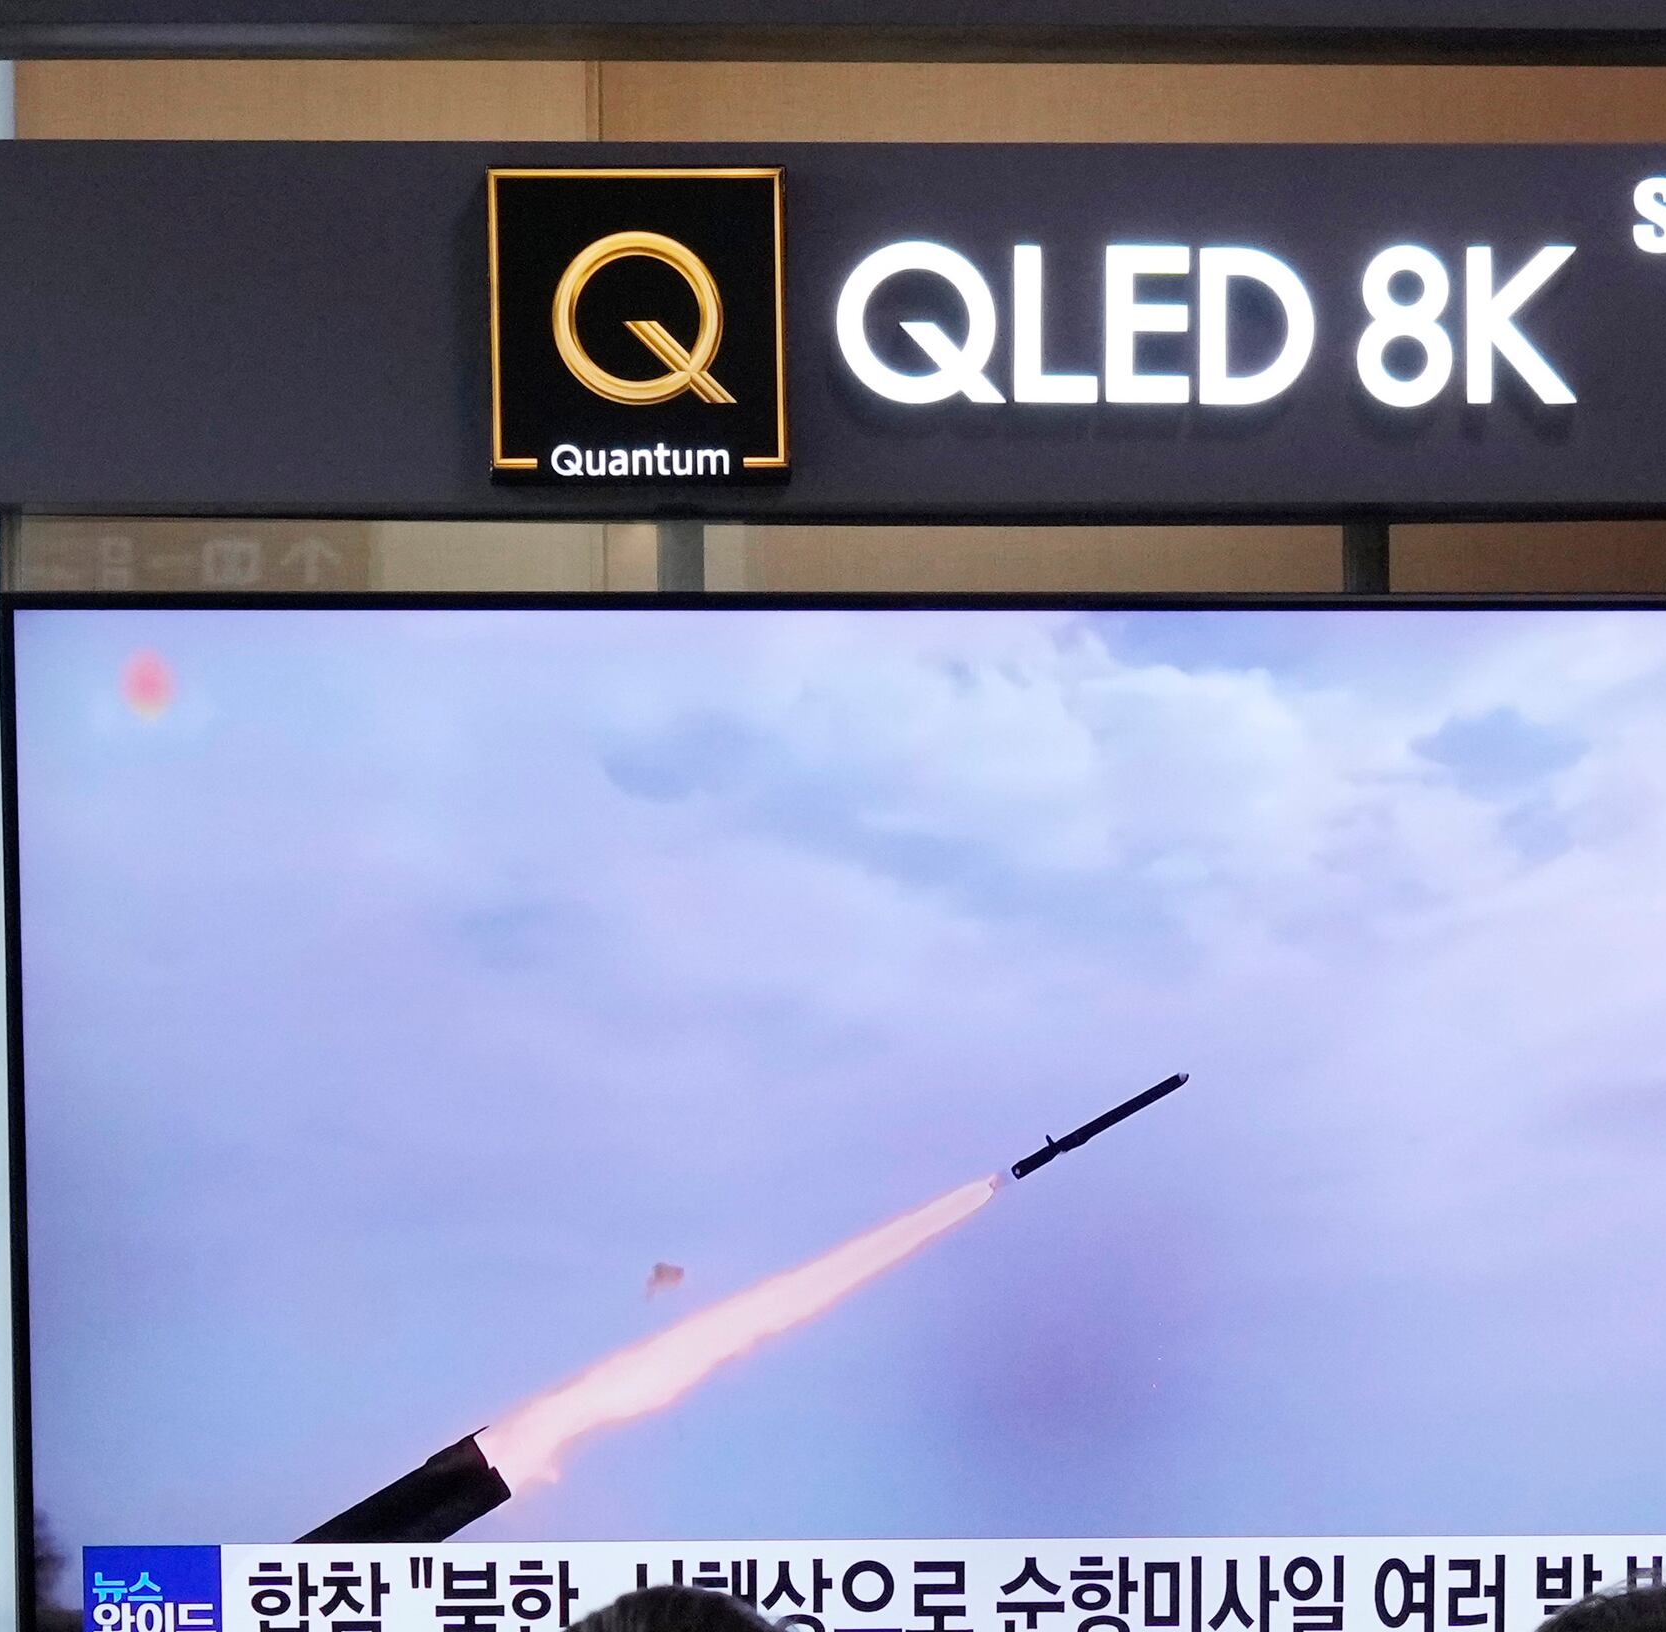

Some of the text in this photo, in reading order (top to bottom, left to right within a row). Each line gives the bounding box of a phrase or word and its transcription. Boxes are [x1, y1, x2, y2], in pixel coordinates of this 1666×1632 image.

[551, 231, 737, 405] Q
[836, 240, 1578, 408] QLED 8K
[550, 442, 730, 478] Quantum
[92, 1571, 164, 1603] 뉴스
